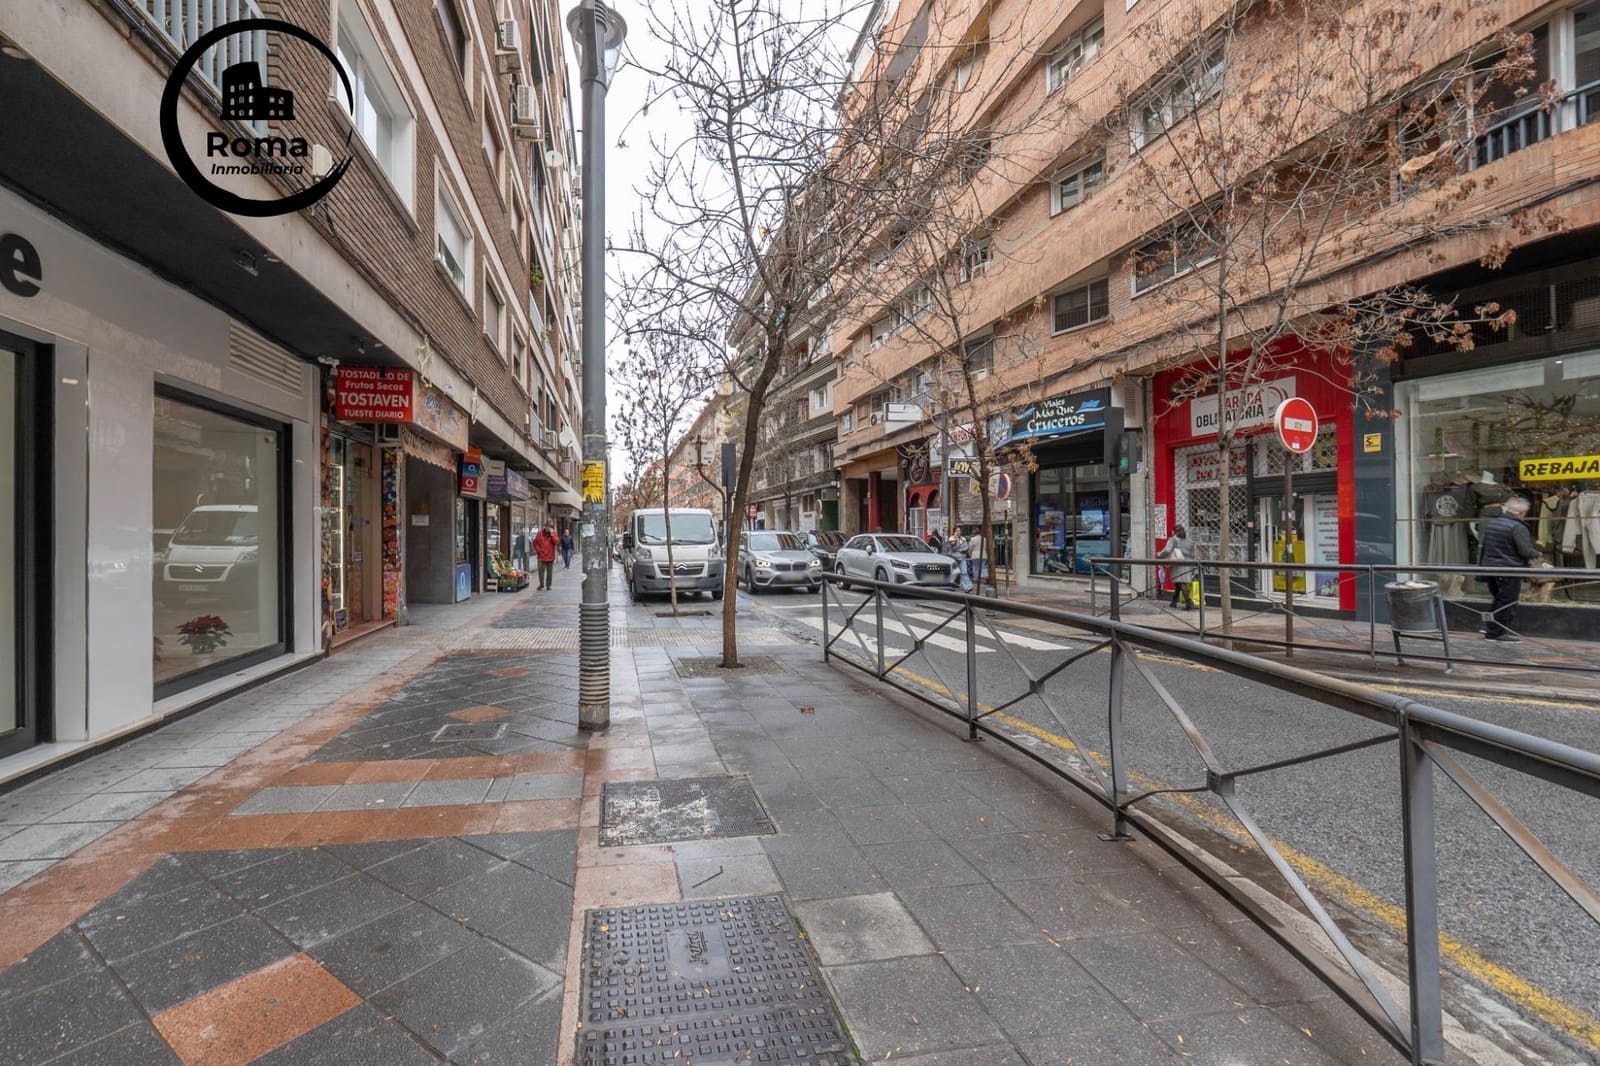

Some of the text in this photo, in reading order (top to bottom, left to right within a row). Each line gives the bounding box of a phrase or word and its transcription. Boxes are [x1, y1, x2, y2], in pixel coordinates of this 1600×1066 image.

[340, 369, 394, 380] TOSTADEO
[345, 381, 403, 391] Frutos Secos
[340, 392, 409, 407] TOSTAVEN
[344, 409, 373, 417] TUESTE
[1027, 414, 1085, 432] Cruceros
